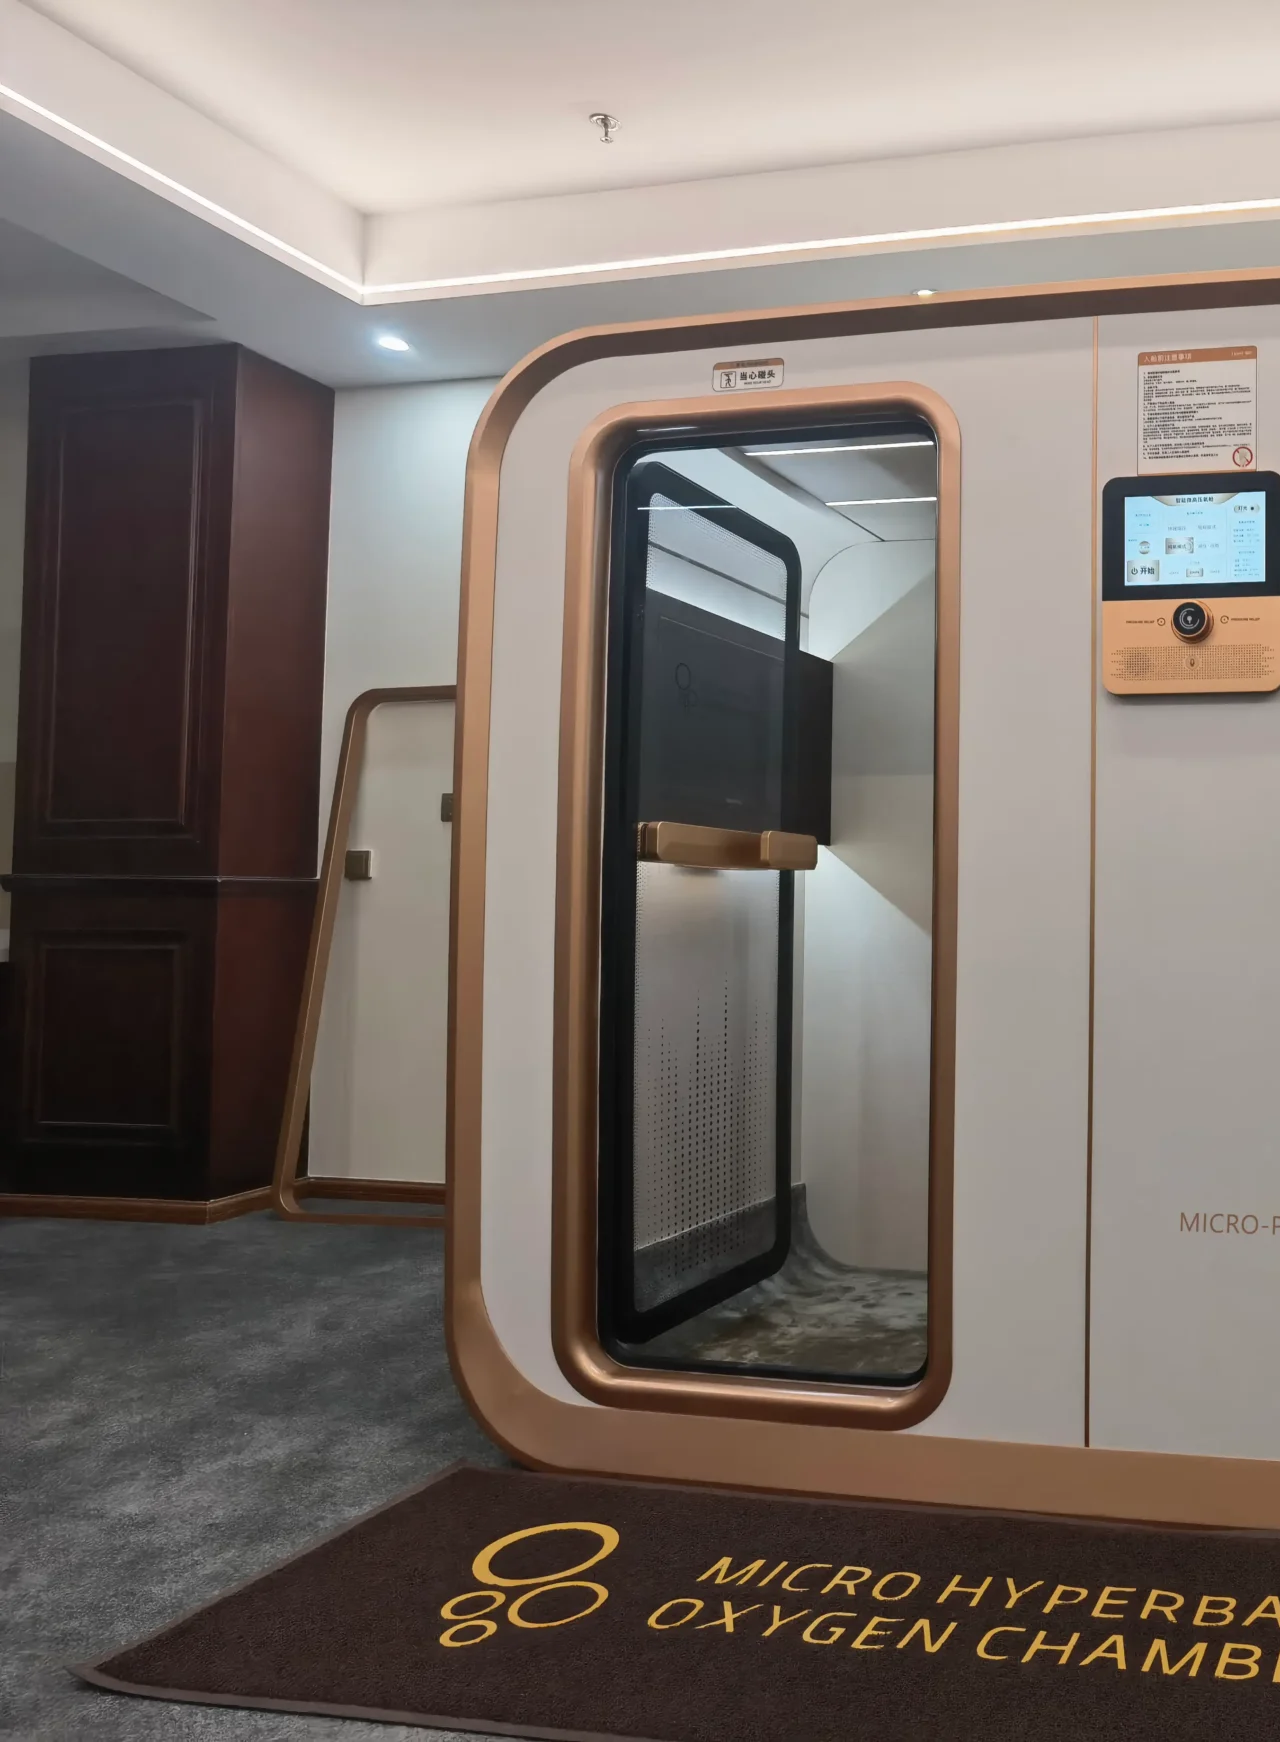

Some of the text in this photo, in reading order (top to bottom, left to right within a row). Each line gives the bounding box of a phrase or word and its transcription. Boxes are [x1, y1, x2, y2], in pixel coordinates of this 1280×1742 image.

[740, 369, 776, 381] 当心碰头
[1140, 567, 1155, 575] 开始
[696, 1556, 922, 1601] MICRO
[647, 1598, 958, 1654] OXYGEN
